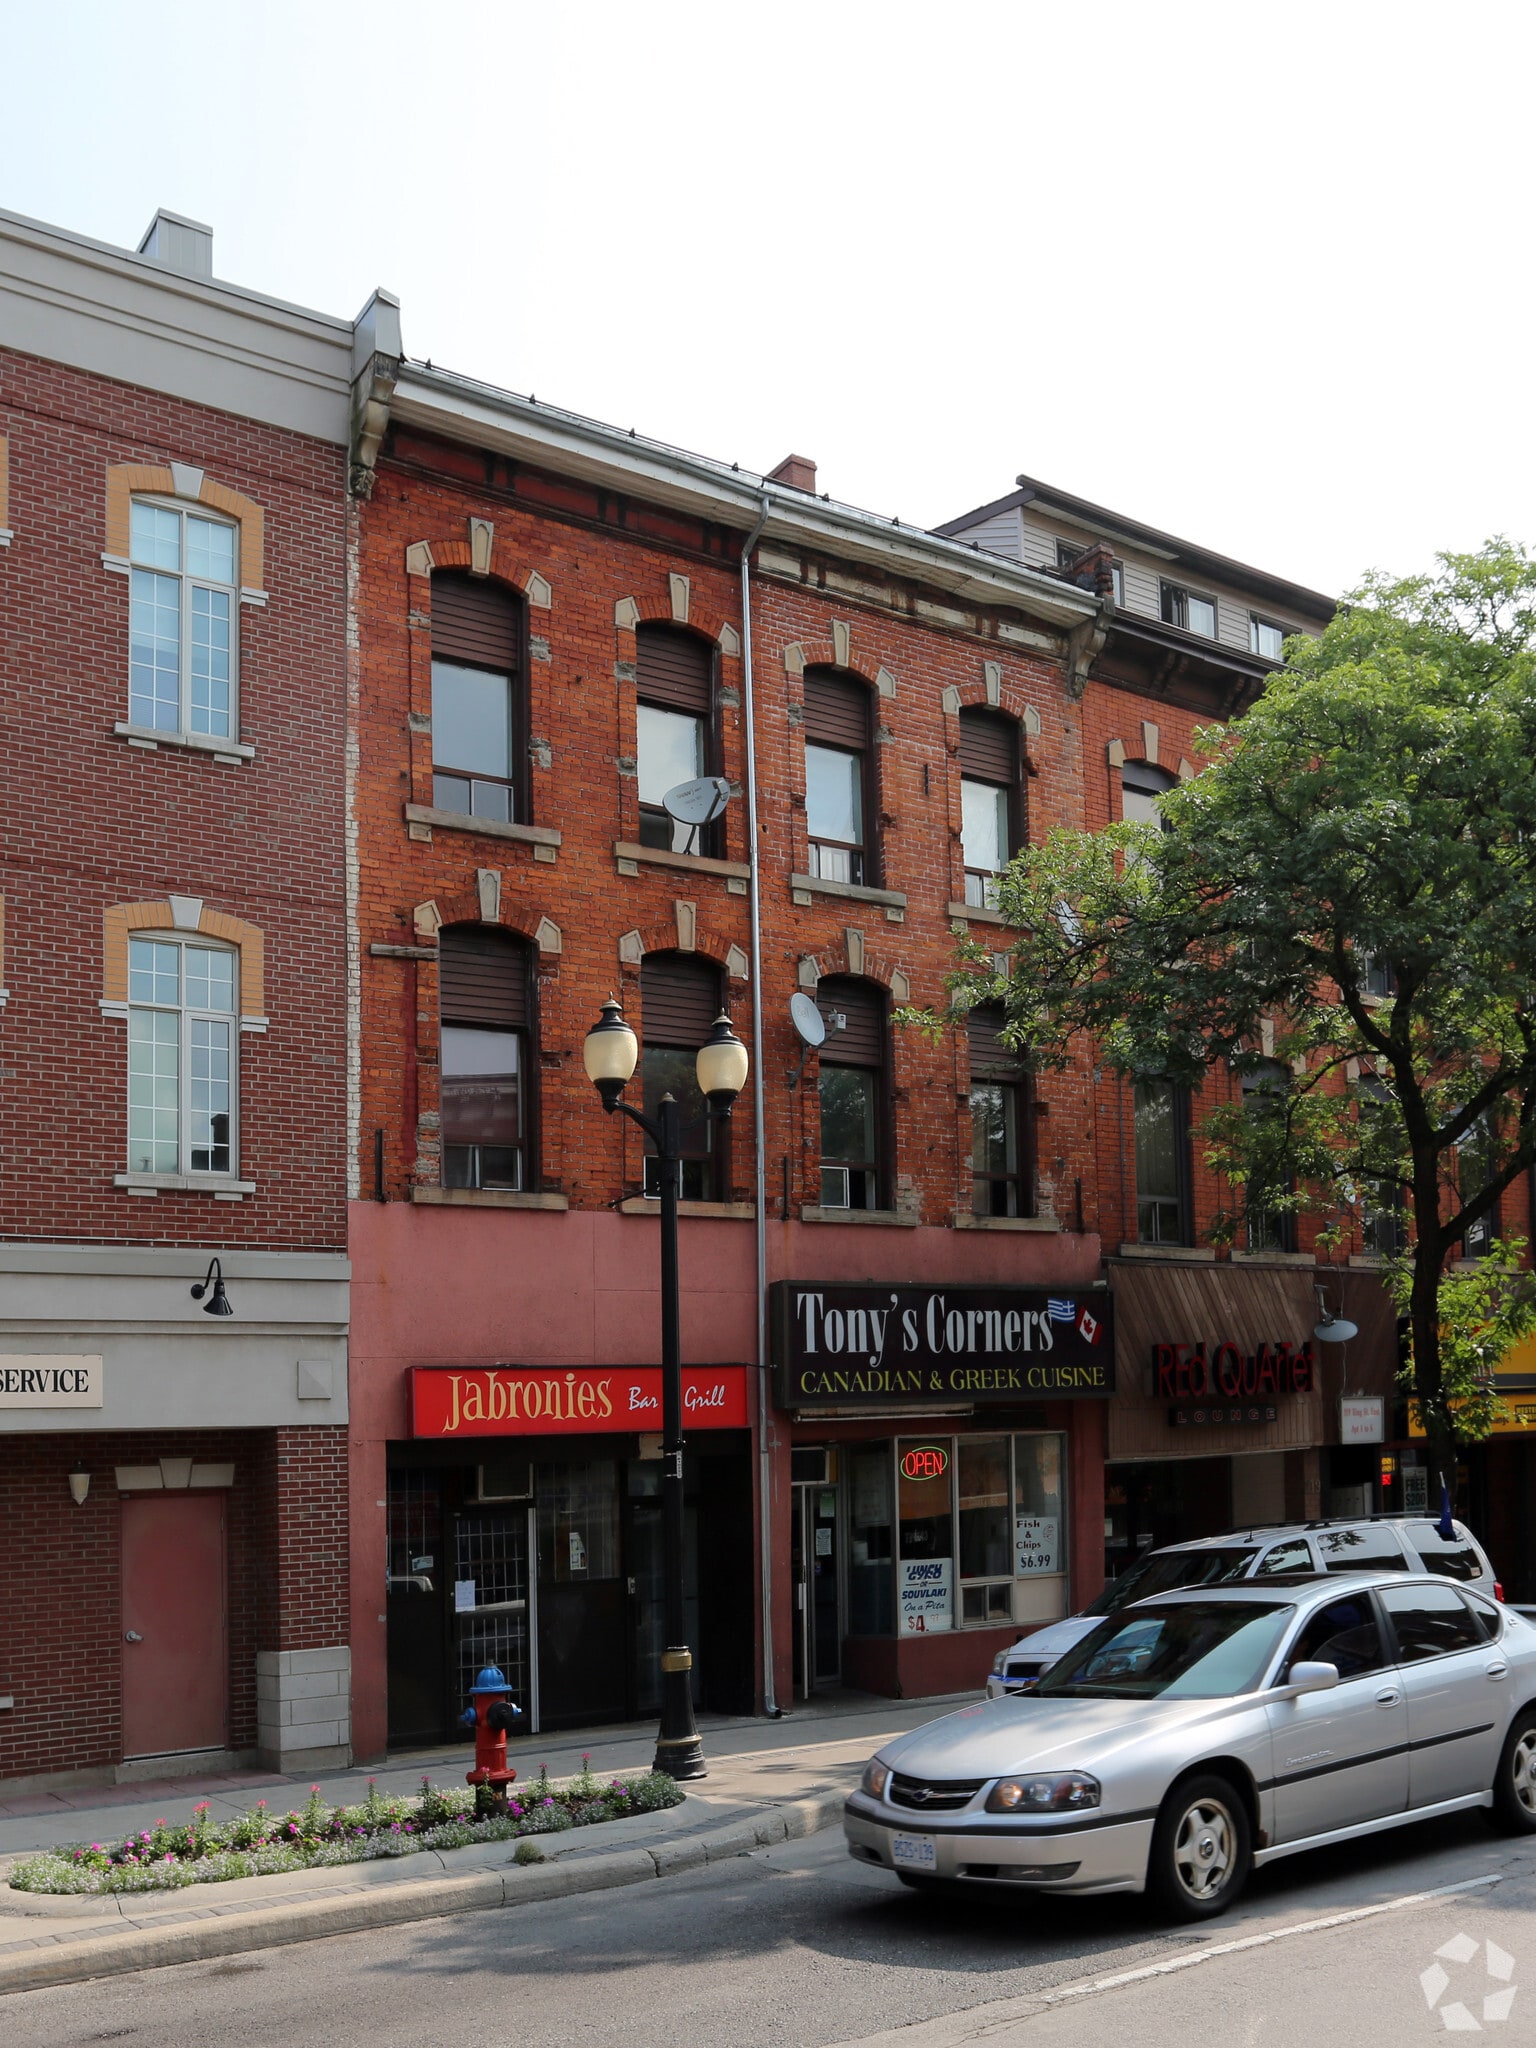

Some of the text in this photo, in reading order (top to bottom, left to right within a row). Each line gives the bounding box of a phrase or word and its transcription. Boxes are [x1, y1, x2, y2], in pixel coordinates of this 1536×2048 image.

[926, 1294, 1054, 1354] Corners
[801, 1366, 1106, 1393] CANADIAN & GREEK CUISINE
[442, 1371, 725, 1433] Jabronies Bar Grill
[1177, 1408, 1276, 1424] LOUNGE
[905, 1452, 943, 1476] OPEN
[1405, 1478, 1427, 1491] FREE
[1016, 1520, 1040, 1528] Fish
[1025, 1531, 1032, 1539] &
[1016, 1541, 1041, 1550] Chips
[1020, 1554, 1051, 1569] $6.99
[901, 1588, 947, 1600] SOUVLAKI
[904, 1602, 916, 1612] On
[925, 1600, 945, 1610] Pita
